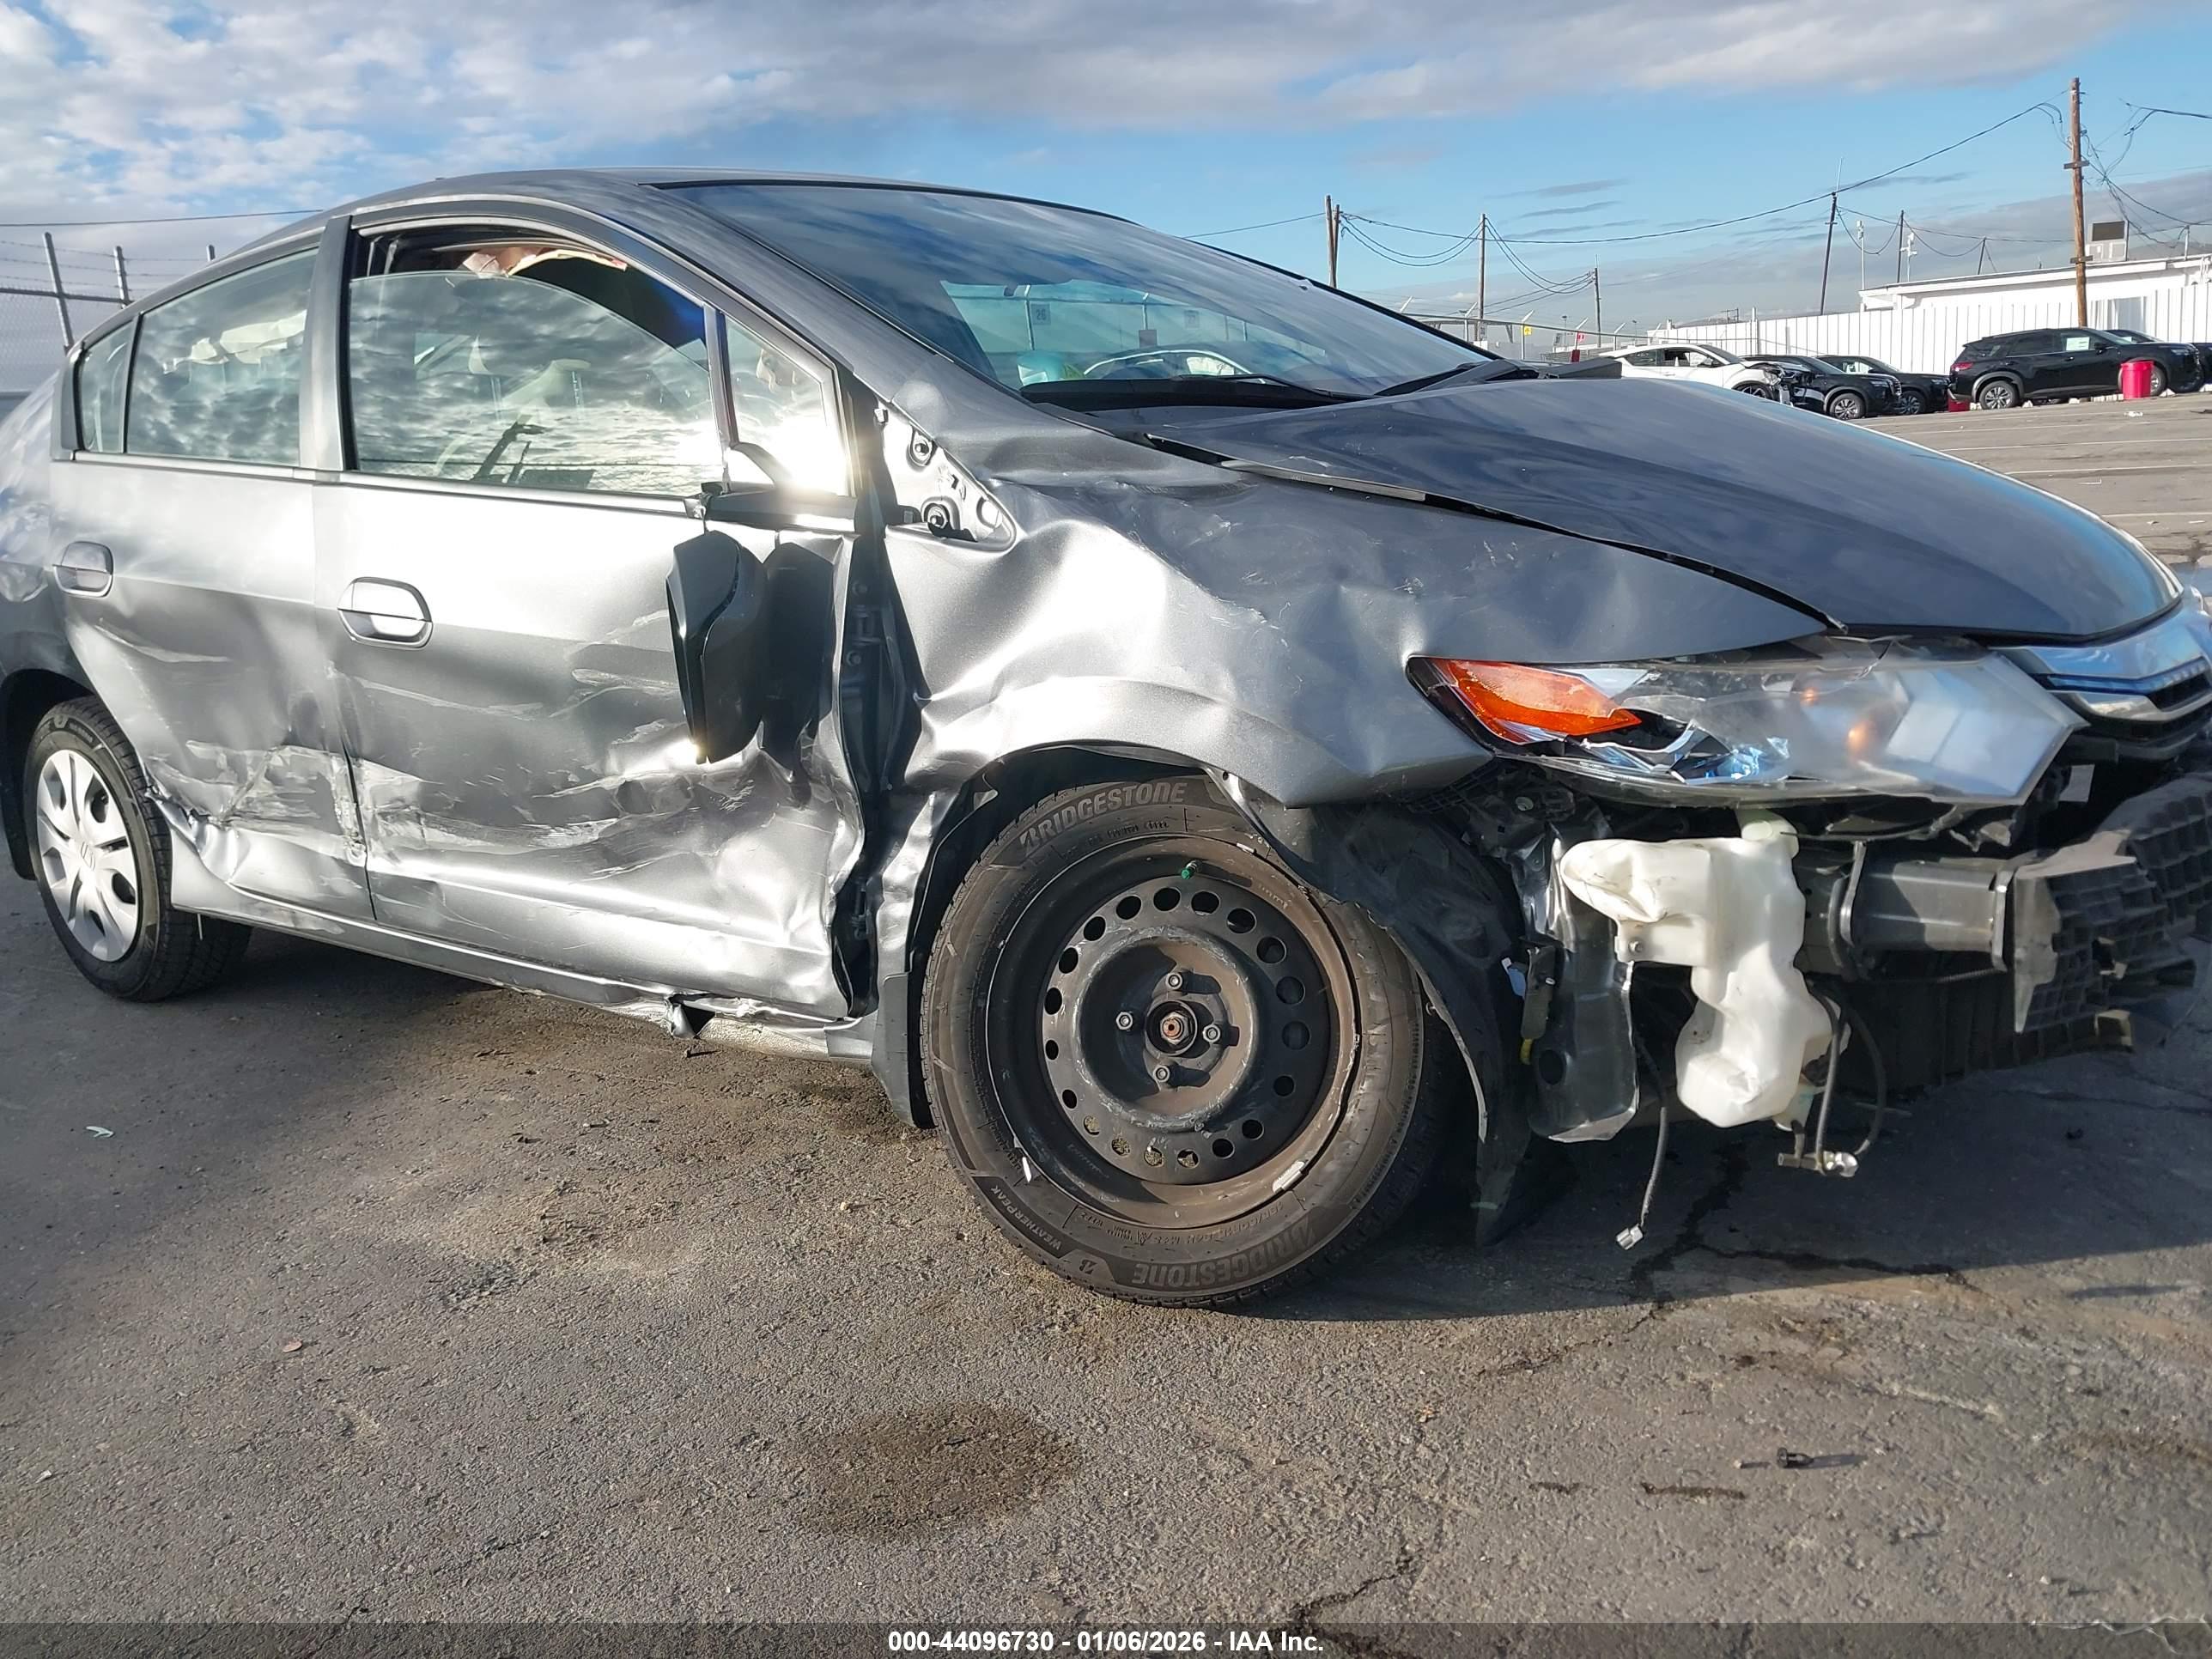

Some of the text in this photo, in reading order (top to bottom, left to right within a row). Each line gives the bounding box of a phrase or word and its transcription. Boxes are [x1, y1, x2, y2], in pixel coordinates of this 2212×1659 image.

[1019, 782, 1188, 858] BRIDGESTONE
[990, 1185, 1063, 1250] WEATHERPEAK
[1131, 1215, 1316, 1287] BRIDGESTONE
